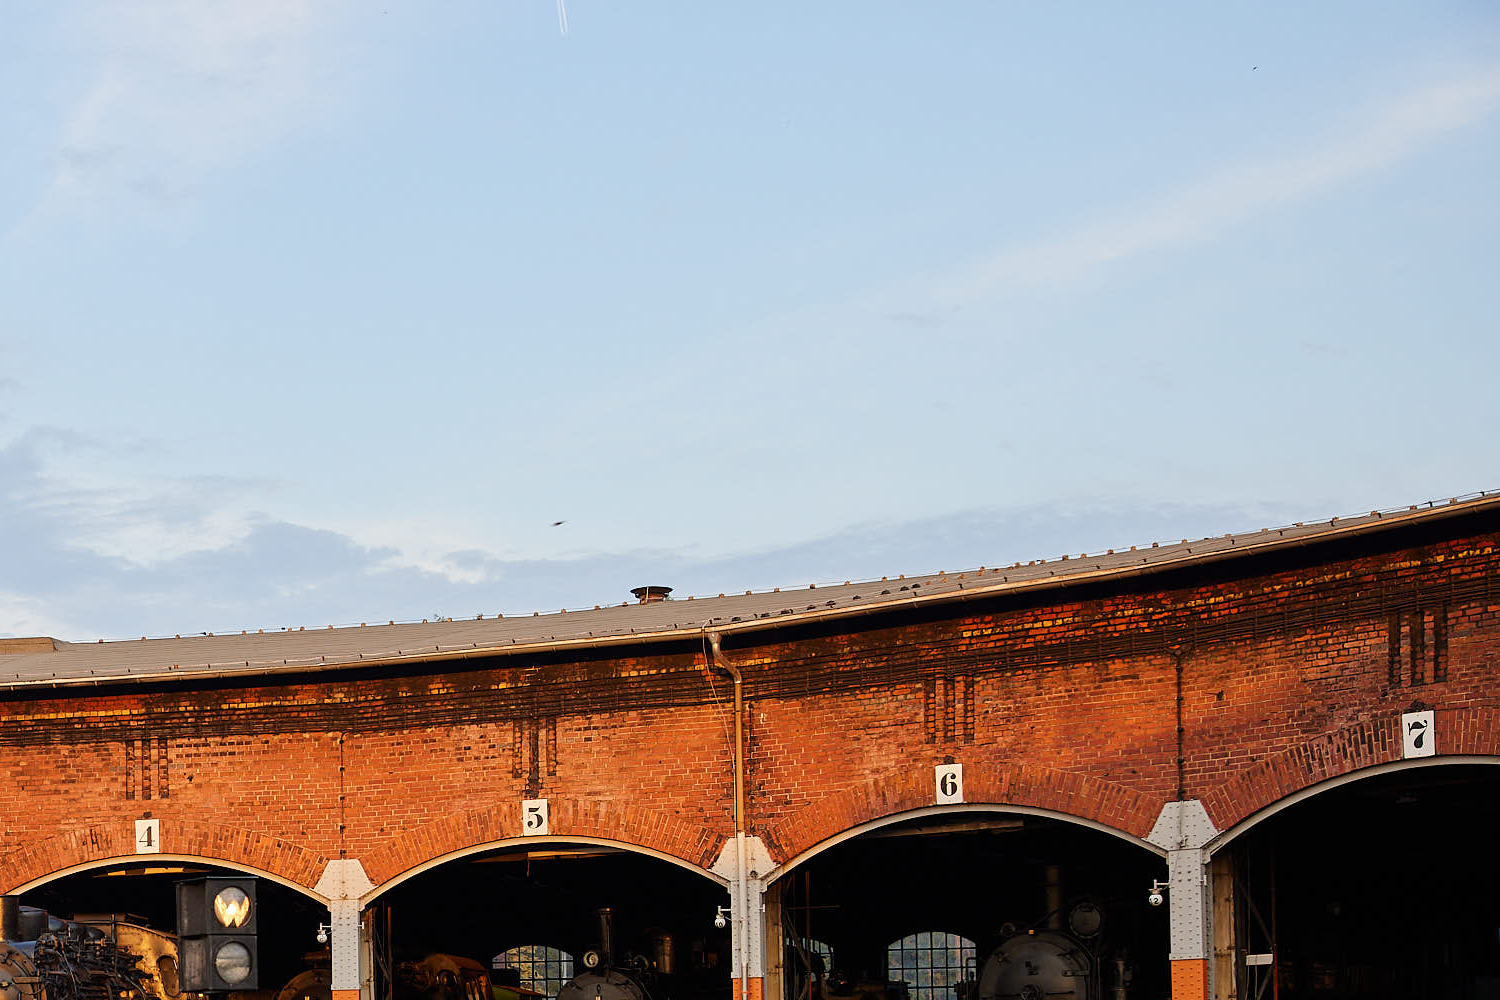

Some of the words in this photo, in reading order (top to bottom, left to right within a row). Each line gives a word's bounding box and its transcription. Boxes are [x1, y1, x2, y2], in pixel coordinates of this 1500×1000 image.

[1407, 719, 1427, 749] 7
[940, 772, 958, 797] 6
[527, 807, 543, 829] 5
[138, 825, 155, 847] 4
